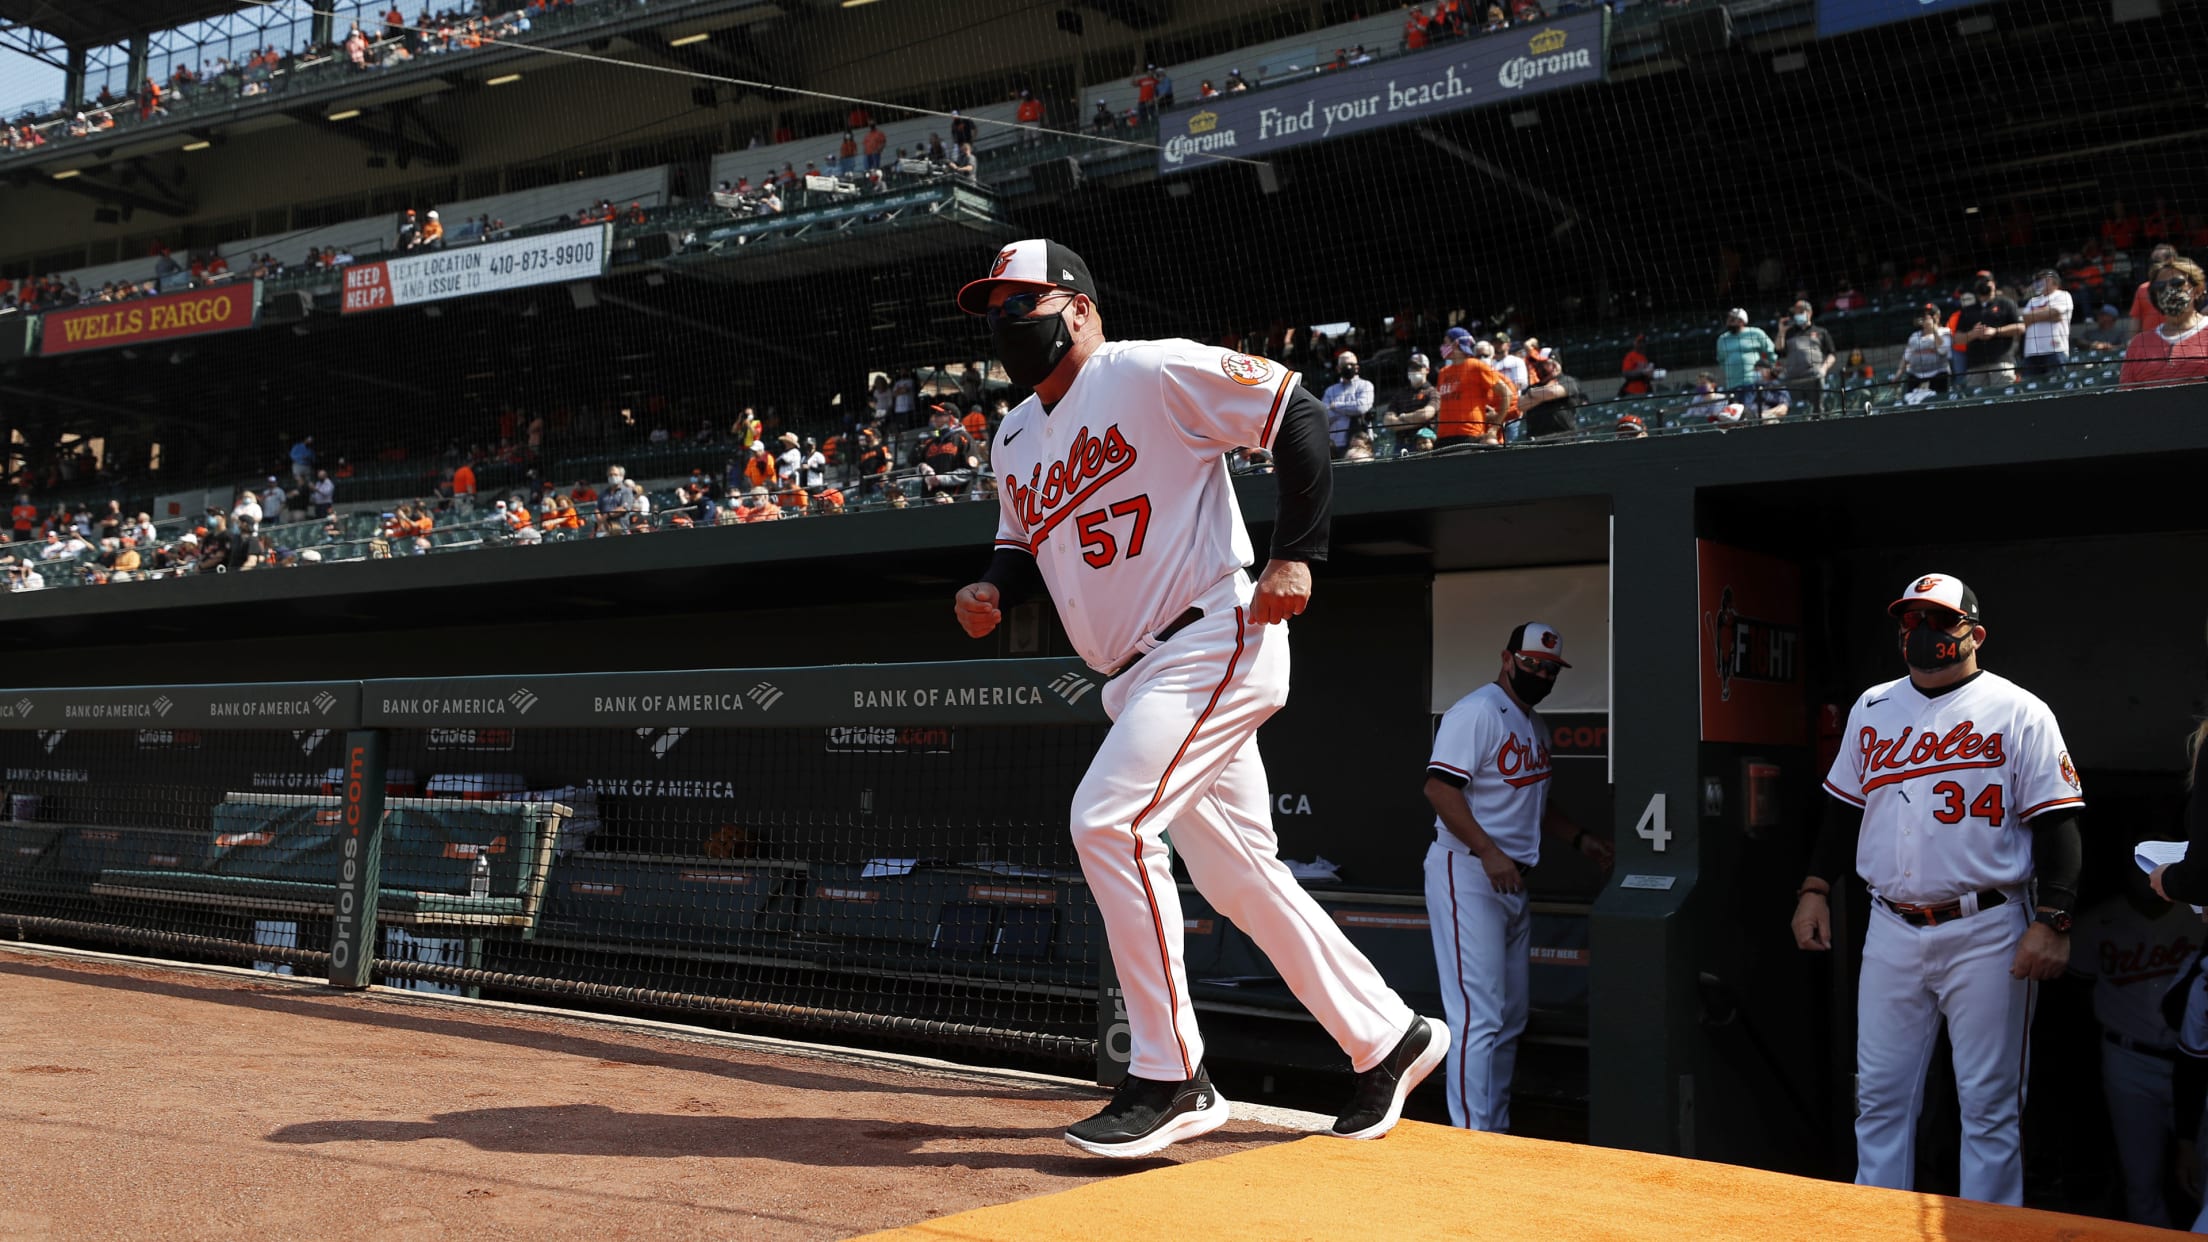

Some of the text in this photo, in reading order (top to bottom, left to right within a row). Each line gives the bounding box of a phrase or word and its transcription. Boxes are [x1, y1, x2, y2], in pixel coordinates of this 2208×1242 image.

[1498, 48, 1592, 90] Corona
[1259, 65, 1473, 141] Find your beach.
[1164, 129, 1237, 164] Corona
[393, 252, 482, 280] TEXT LOCATION
[489, 241, 594, 275] 410-873-9900
[347, 266, 381, 288] NEED
[402, 271, 481, 298] AND ISSUE TO
[346, 286, 386, 309] HELP?
[63, 295, 232, 342] WELLS FARGO
[1076, 493, 1152, 569] 57
[1935, 642, 1957, 660] 34
[210, 701, 311, 716] BANK OF AMERICA
[383, 698, 505, 714] BANK OF AMERICA
[594, 694, 744, 712] BANK OF AMERICA
[853, 686, 1044, 708] BANK OF AMERICA
[65, 704, 151, 718] BANK OF AMERICA
[6, 767, 33, 781] BANK
[287, 772, 303, 788] OF
[586, 778, 735, 799] BANK OF AMERICA
[1933, 780, 2005, 827] 34
[1635, 793, 1672, 851] 4
[332, 747, 365, 969] Orioles.com
